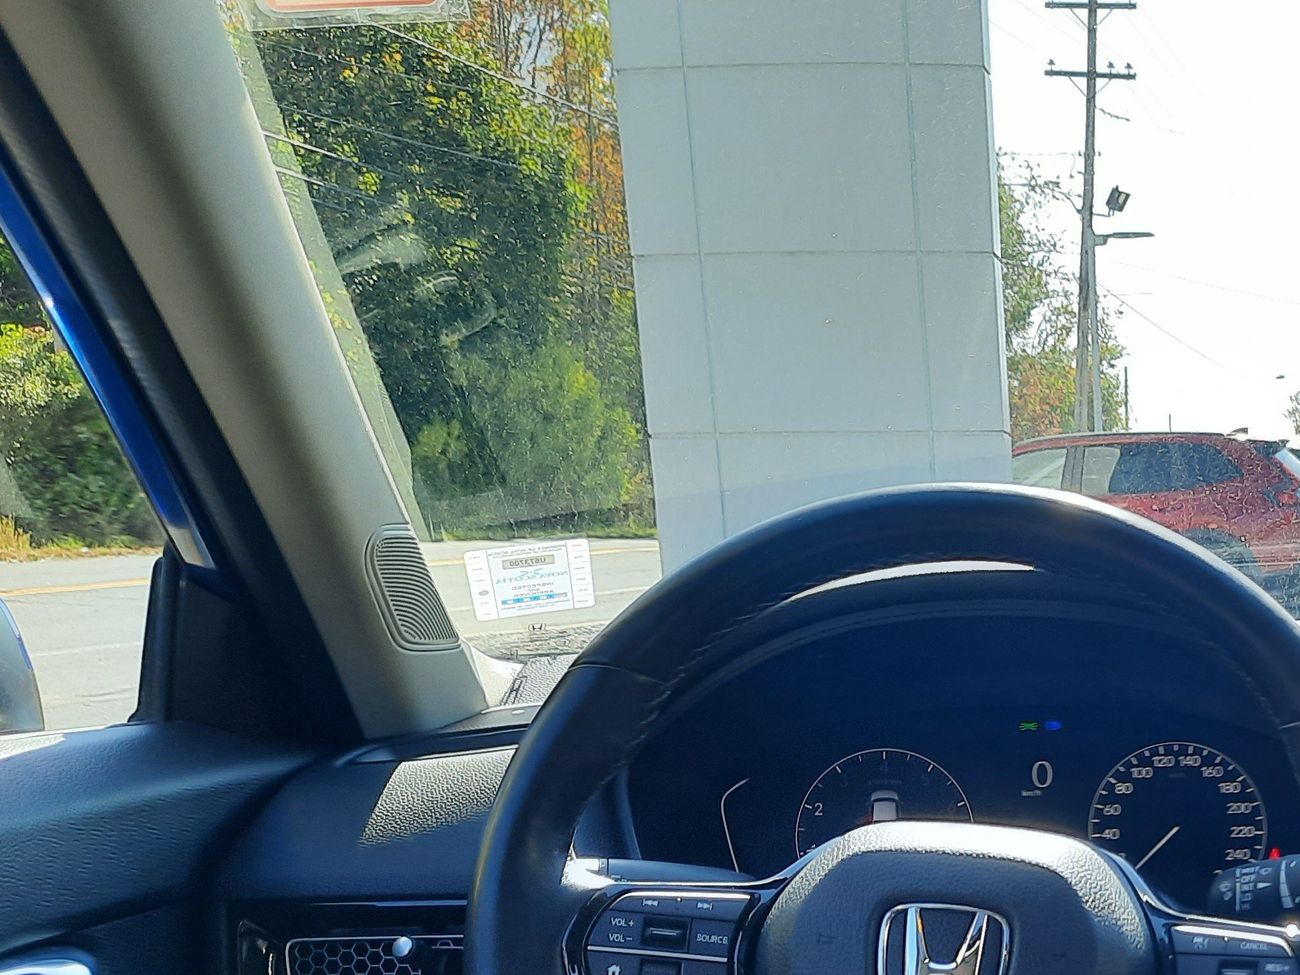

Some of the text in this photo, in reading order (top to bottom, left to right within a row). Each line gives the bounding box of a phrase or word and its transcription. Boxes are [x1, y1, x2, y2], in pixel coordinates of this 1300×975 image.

[1152, 755, 1175, 767] 120
[1178, 755, 1201, 767] 140
[1031, 761, 1053, 788] 0
[1130, 767, 1153, 778] 100
[1201, 766, 1224, 778] 160
[1114, 782, 1134, 794] 80
[1218, 782, 1241, 793] 180
[814, 802, 823, 816] 2
[1103, 804, 1122, 816] 60
[1226, 802, 1252, 814] 200
[1102, 828, 1121, 840] 40
[1230, 826, 1256, 838] 220
[1224, 849, 1251, 860] 240
[1240, 874, 1256, 883] OFF
[696, 933, 729, 945] SOURCE
[1240, 942, 1268, 950] CANCEL
